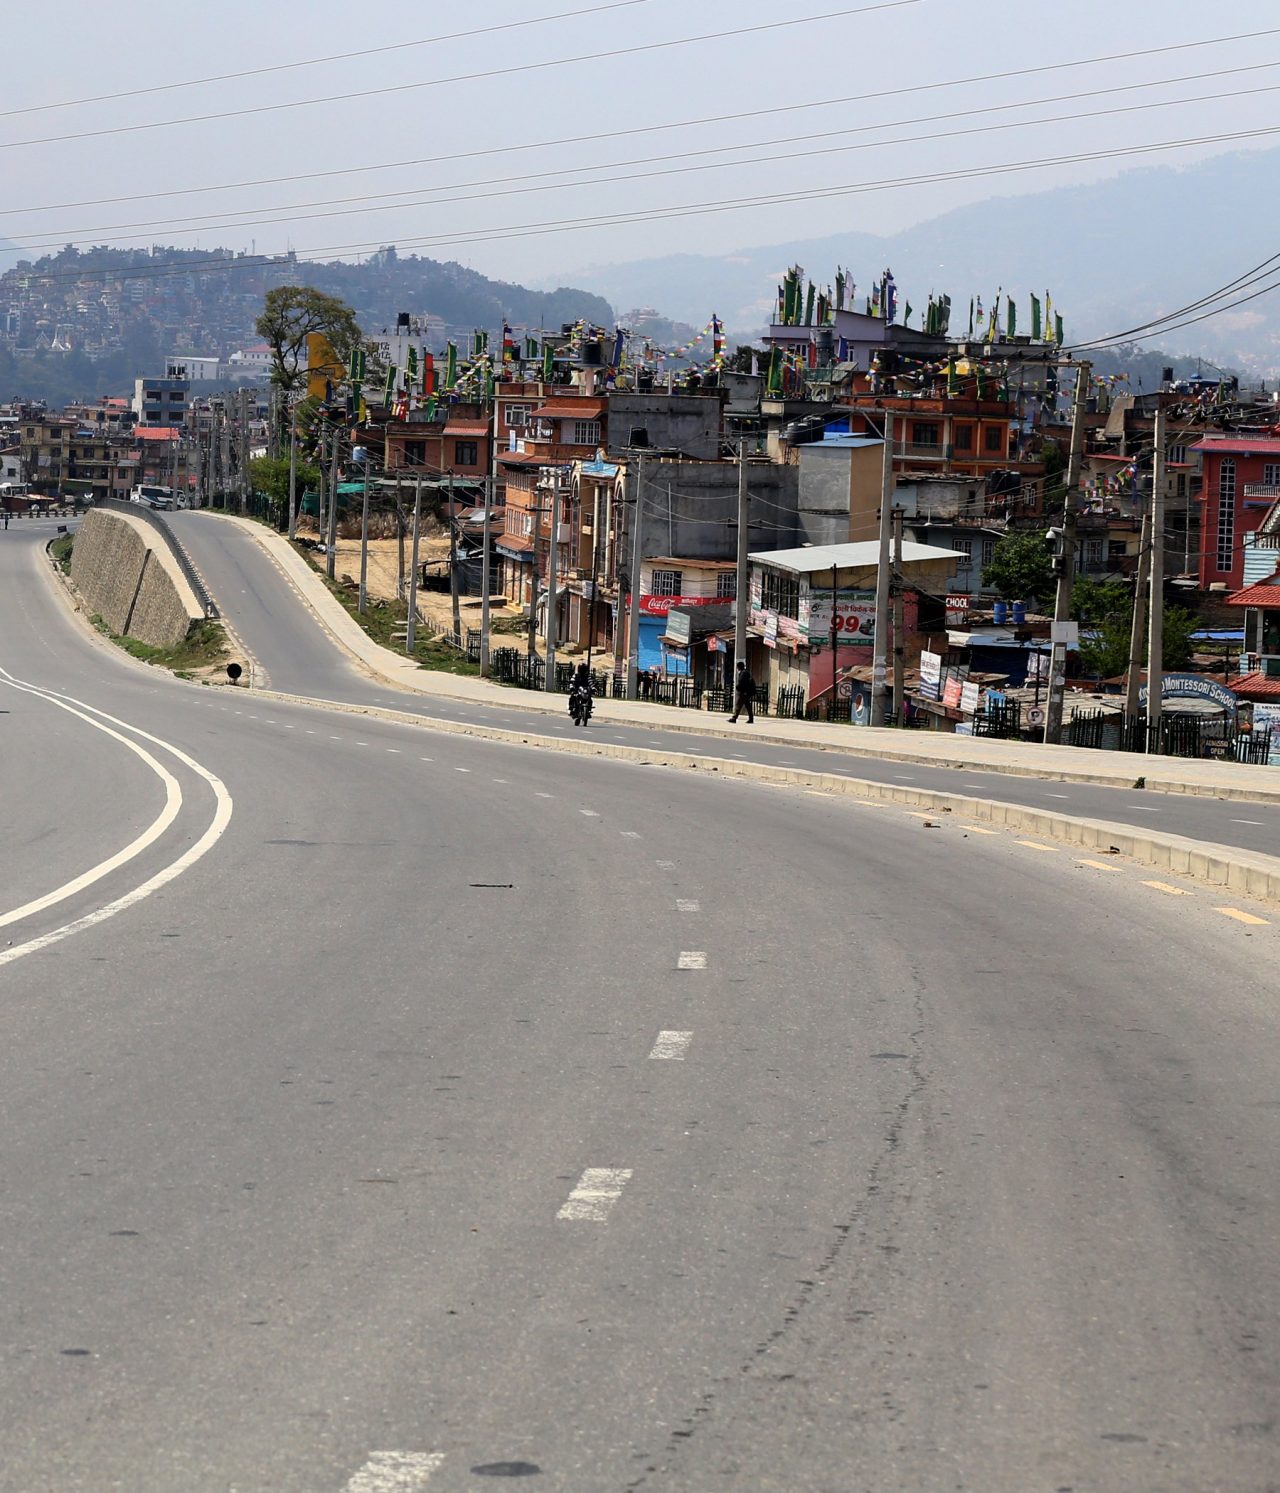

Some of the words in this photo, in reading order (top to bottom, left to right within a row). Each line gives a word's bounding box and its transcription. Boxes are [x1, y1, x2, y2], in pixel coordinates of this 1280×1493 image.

[830, 614, 859, 633] 99
[1165, 677, 1210, 693] MONTESSORI
[1210, 685, 1235, 709] SCHOOL
